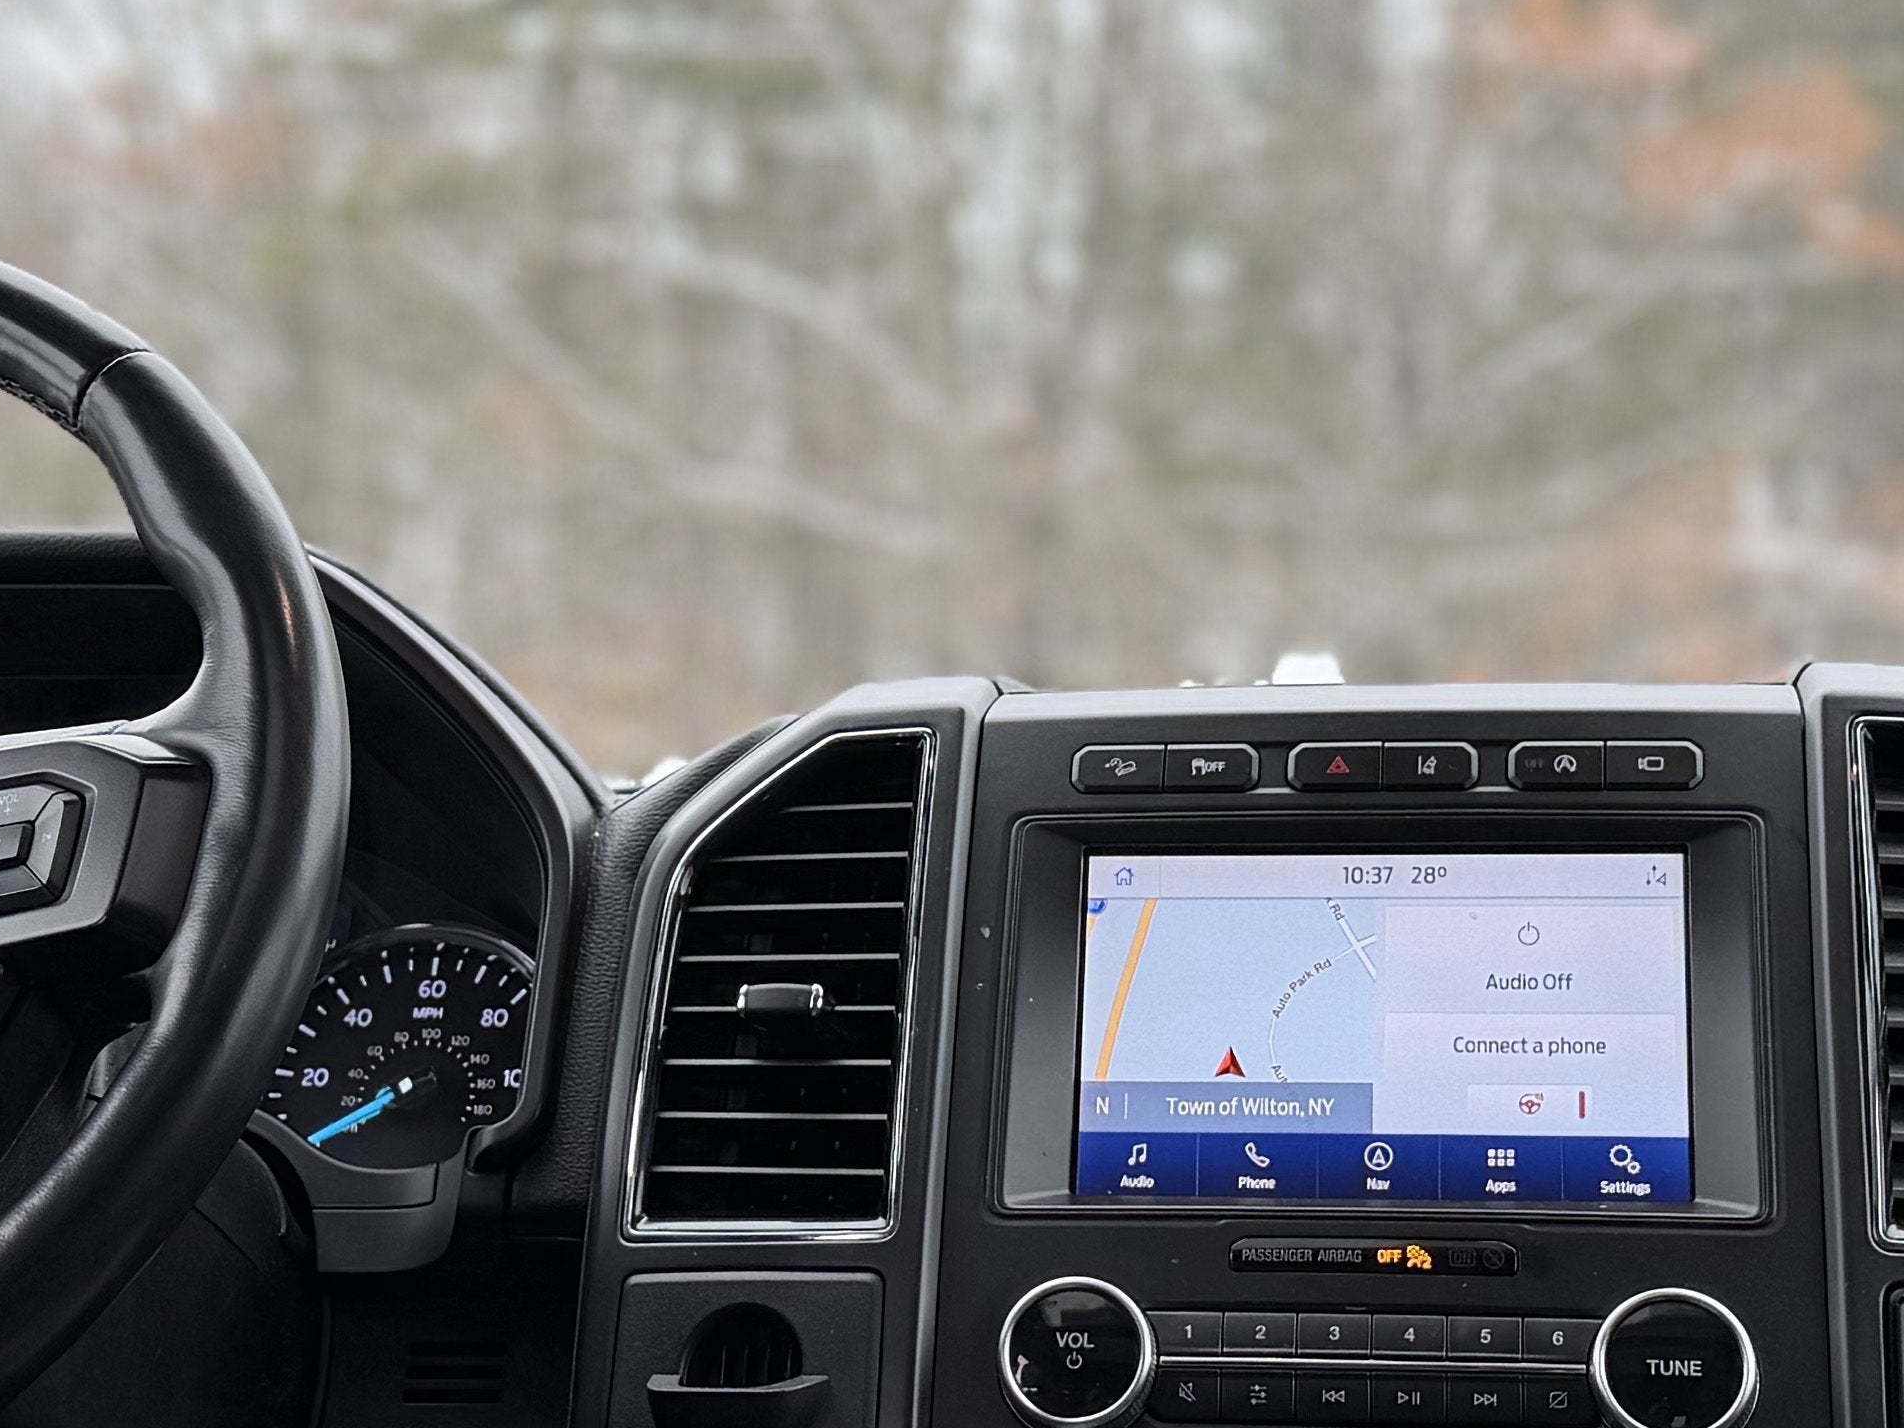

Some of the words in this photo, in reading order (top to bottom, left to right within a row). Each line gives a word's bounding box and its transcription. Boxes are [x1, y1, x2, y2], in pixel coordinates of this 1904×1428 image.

[1204, 760, 1226, 773] OFF
[1342, 866, 1394, 885] 10:37
[1329, 903, 1345, 921] Rd
[418, 979, 447, 999] 60
[1271, 991, 1292, 1019] Auto
[1289, 969, 1314, 993] Park
[1313, 958, 1332, 974] Rd
[1485, 973, 1539, 990] Audio
[1543, 973, 1573, 990] Off
[343, 1008, 373, 1028] 40
[412, 1006, 444, 1019] MPH
[480, 1008, 509, 1028] 80
[394, 1032, 410, 1043] 80
[421, 1028, 442, 1040] 100
[450, 1035, 470, 1046] 120
[367, 1045, 383, 1057] 60
[1452, 1036, 1528, 1054] Connect
[1532, 1041, 1543, 1054] a
[1547, 1036, 1607, 1057] phone
[470, 1054, 490, 1065] 140
[301, 1067, 330, 1087] 20
[347, 1068, 364, 1080] 40
[476, 1078, 496, 1090] 160
[340, 1095, 356, 1107] 20
[1096, 1097, 1110, 1115] N
[1166, 1097, 1215, 1115] Town
[1218, 1096, 1238, 1115] of
[1241, 1096, 1305, 1118] Wilton,
[1308, 1098, 1335, 1116] NY
[1120, 1175, 1155, 1189] Audio
[1238, 1176, 1277, 1190] Phone
[1366, 1177, 1391, 1191] Nav
[1485, 1178, 1516, 1194] Apps
[1599, 1180, 1651, 1197] Settings
[1241, 1248, 1313, 1262] PASSENGER
[1317, 1248, 1363, 1263] AIRBAG
[1377, 1249, 1402, 1263] OFF
[1056, 1331, 1095, 1348] VOL
[1183, 1324, 1193, 1340] 1
[1255, 1325, 1267, 1340] 2
[1328, 1325, 1341, 1341] 3
[1403, 1327, 1416, 1341] 4
[1479, 1329, 1492, 1344] 5
[1551, 1330, 1564, 1345] 6
[1646, 1359, 1704, 1376] TUNE
